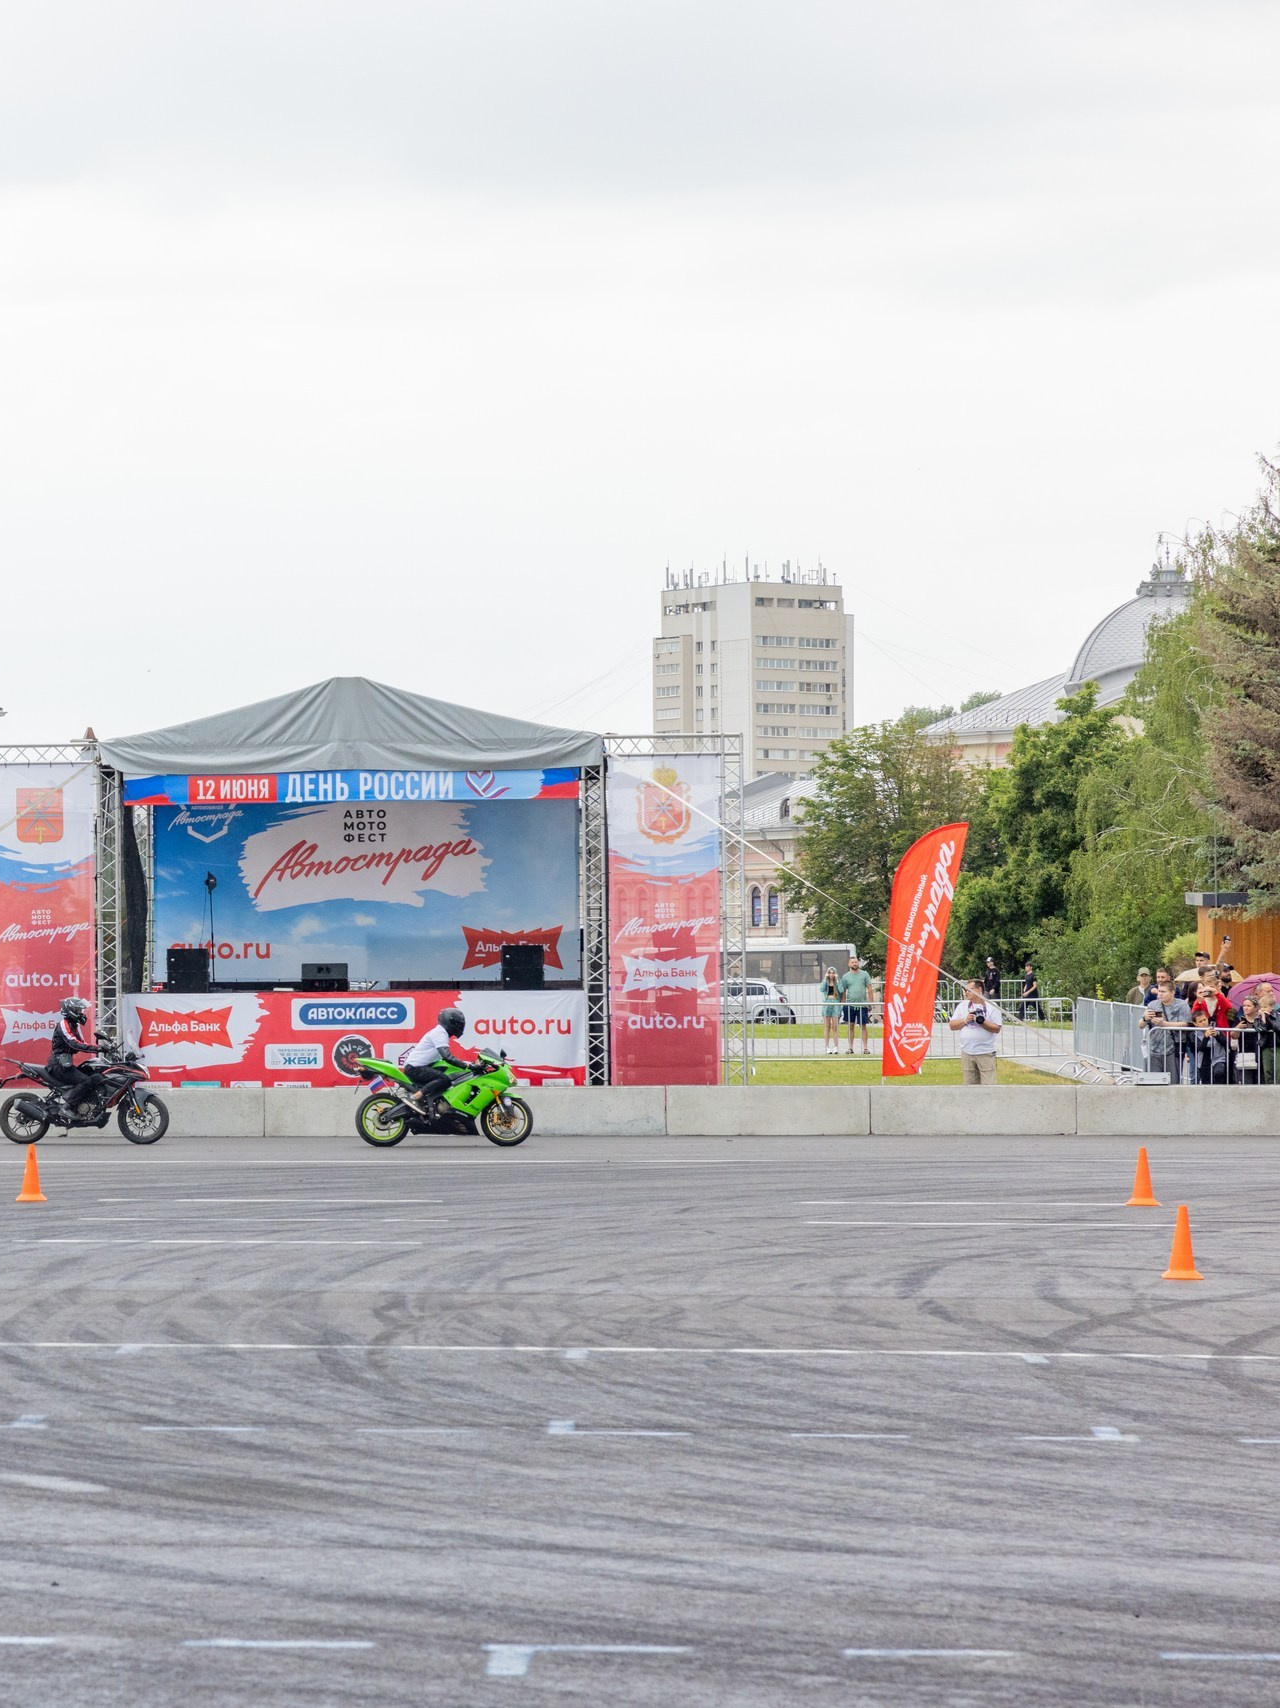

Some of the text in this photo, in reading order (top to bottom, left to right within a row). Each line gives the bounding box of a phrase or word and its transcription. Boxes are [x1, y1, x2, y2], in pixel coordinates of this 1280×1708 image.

[197, 772, 453, 803] 12 ИЮНЯ ДЕНЬ РОССИИ
[168, 810, 244, 831] Автострада
[343, 809, 387, 819] АВТО
[343, 821, 387, 831] МОТО
[343, 833, 387, 843] ФЕСТ
[254, 838, 477, 899] Автострада
[903, 874, 928, 943] АВТОМОБИЛЬНЫЙ
[614, 917, 716, 943] Автострада
[5, 972, 80, 987] auto.ru
[633, 967, 697, 980] Альфа Банк
[308, 1007, 398, 1020] АВТОКЛАСС
[628, 1013, 705, 1029] auto.ru
[12, 1020, 47, 1033] Альфа
[148, 1021, 221, 1036] Альфа Банк
[474, 1016, 572, 1035] auto.ru
[283, 1056, 318, 1065] ЖБИ
